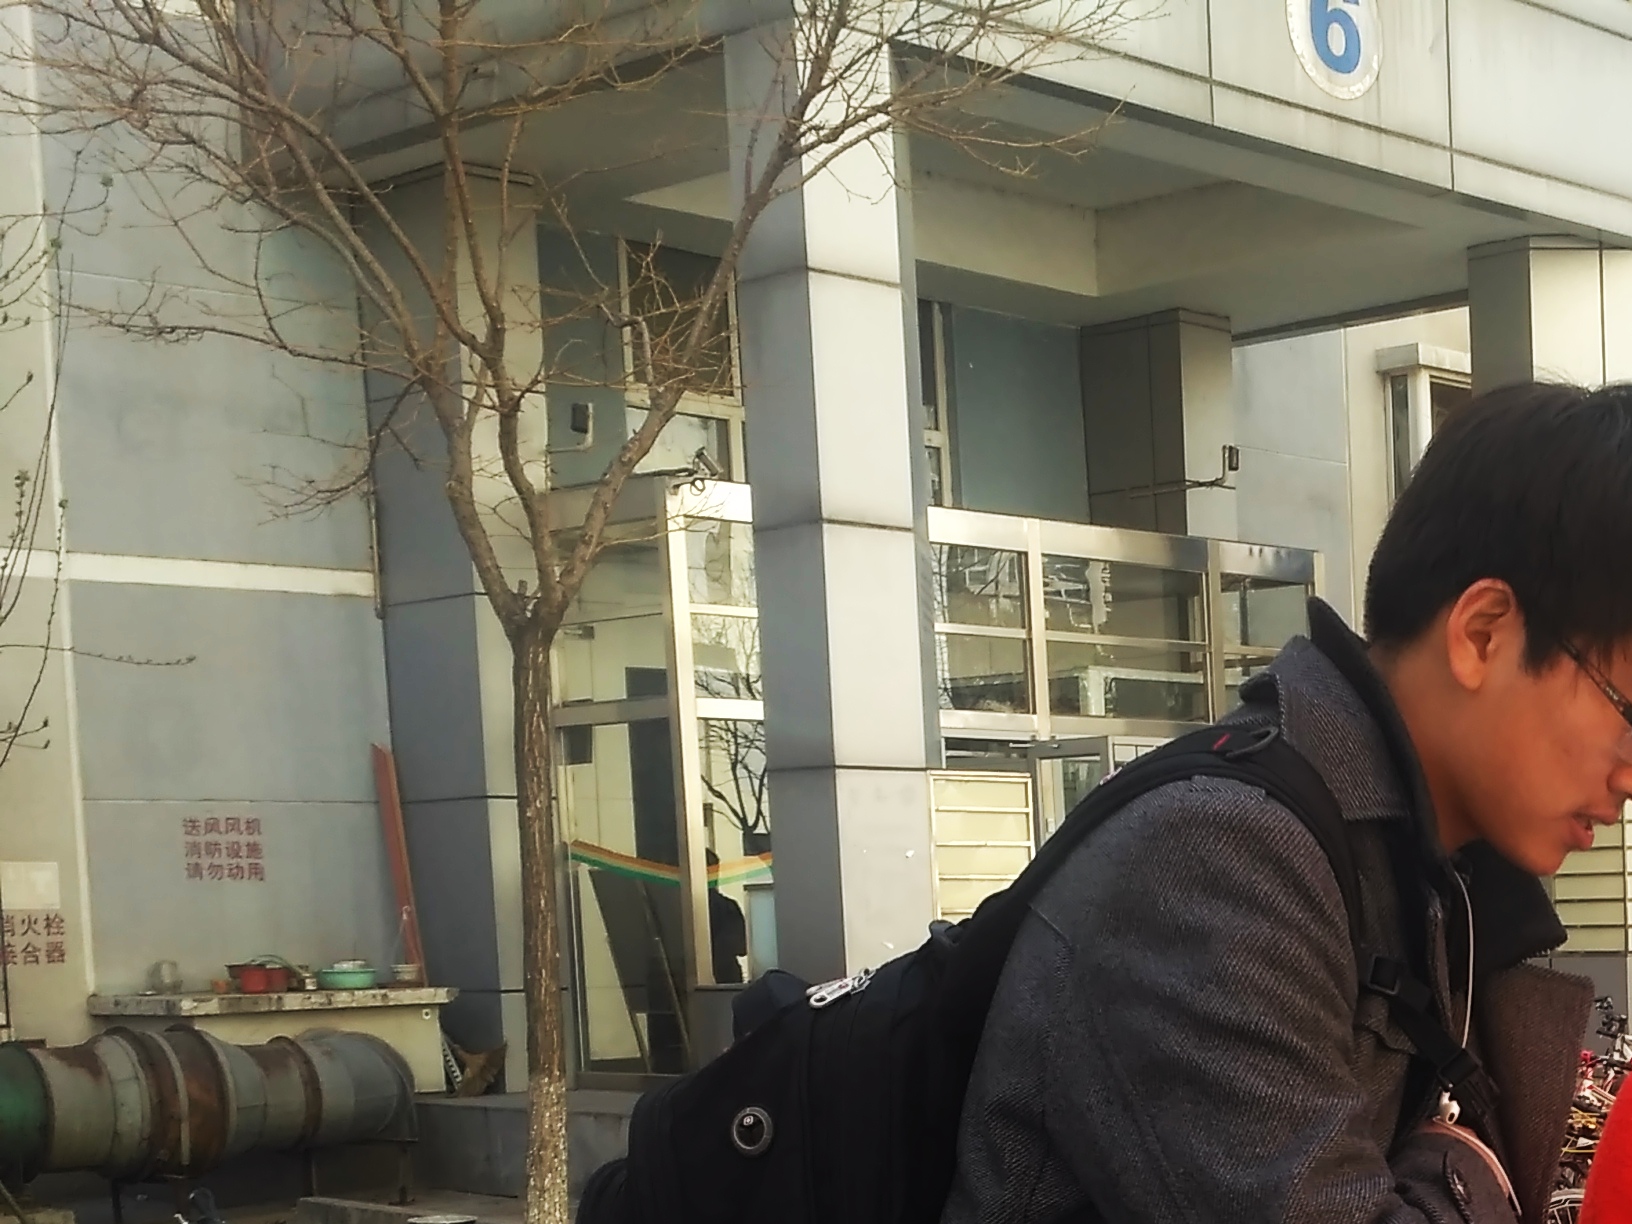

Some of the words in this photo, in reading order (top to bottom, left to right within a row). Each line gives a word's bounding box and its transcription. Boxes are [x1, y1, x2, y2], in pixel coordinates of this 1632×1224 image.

[1310, 0, 1361, 74] 6
[182, 816, 262, 836] 送风风机
[184, 841, 264, 859] 消防设施
[185, 862, 266, 882] 请勿动用
